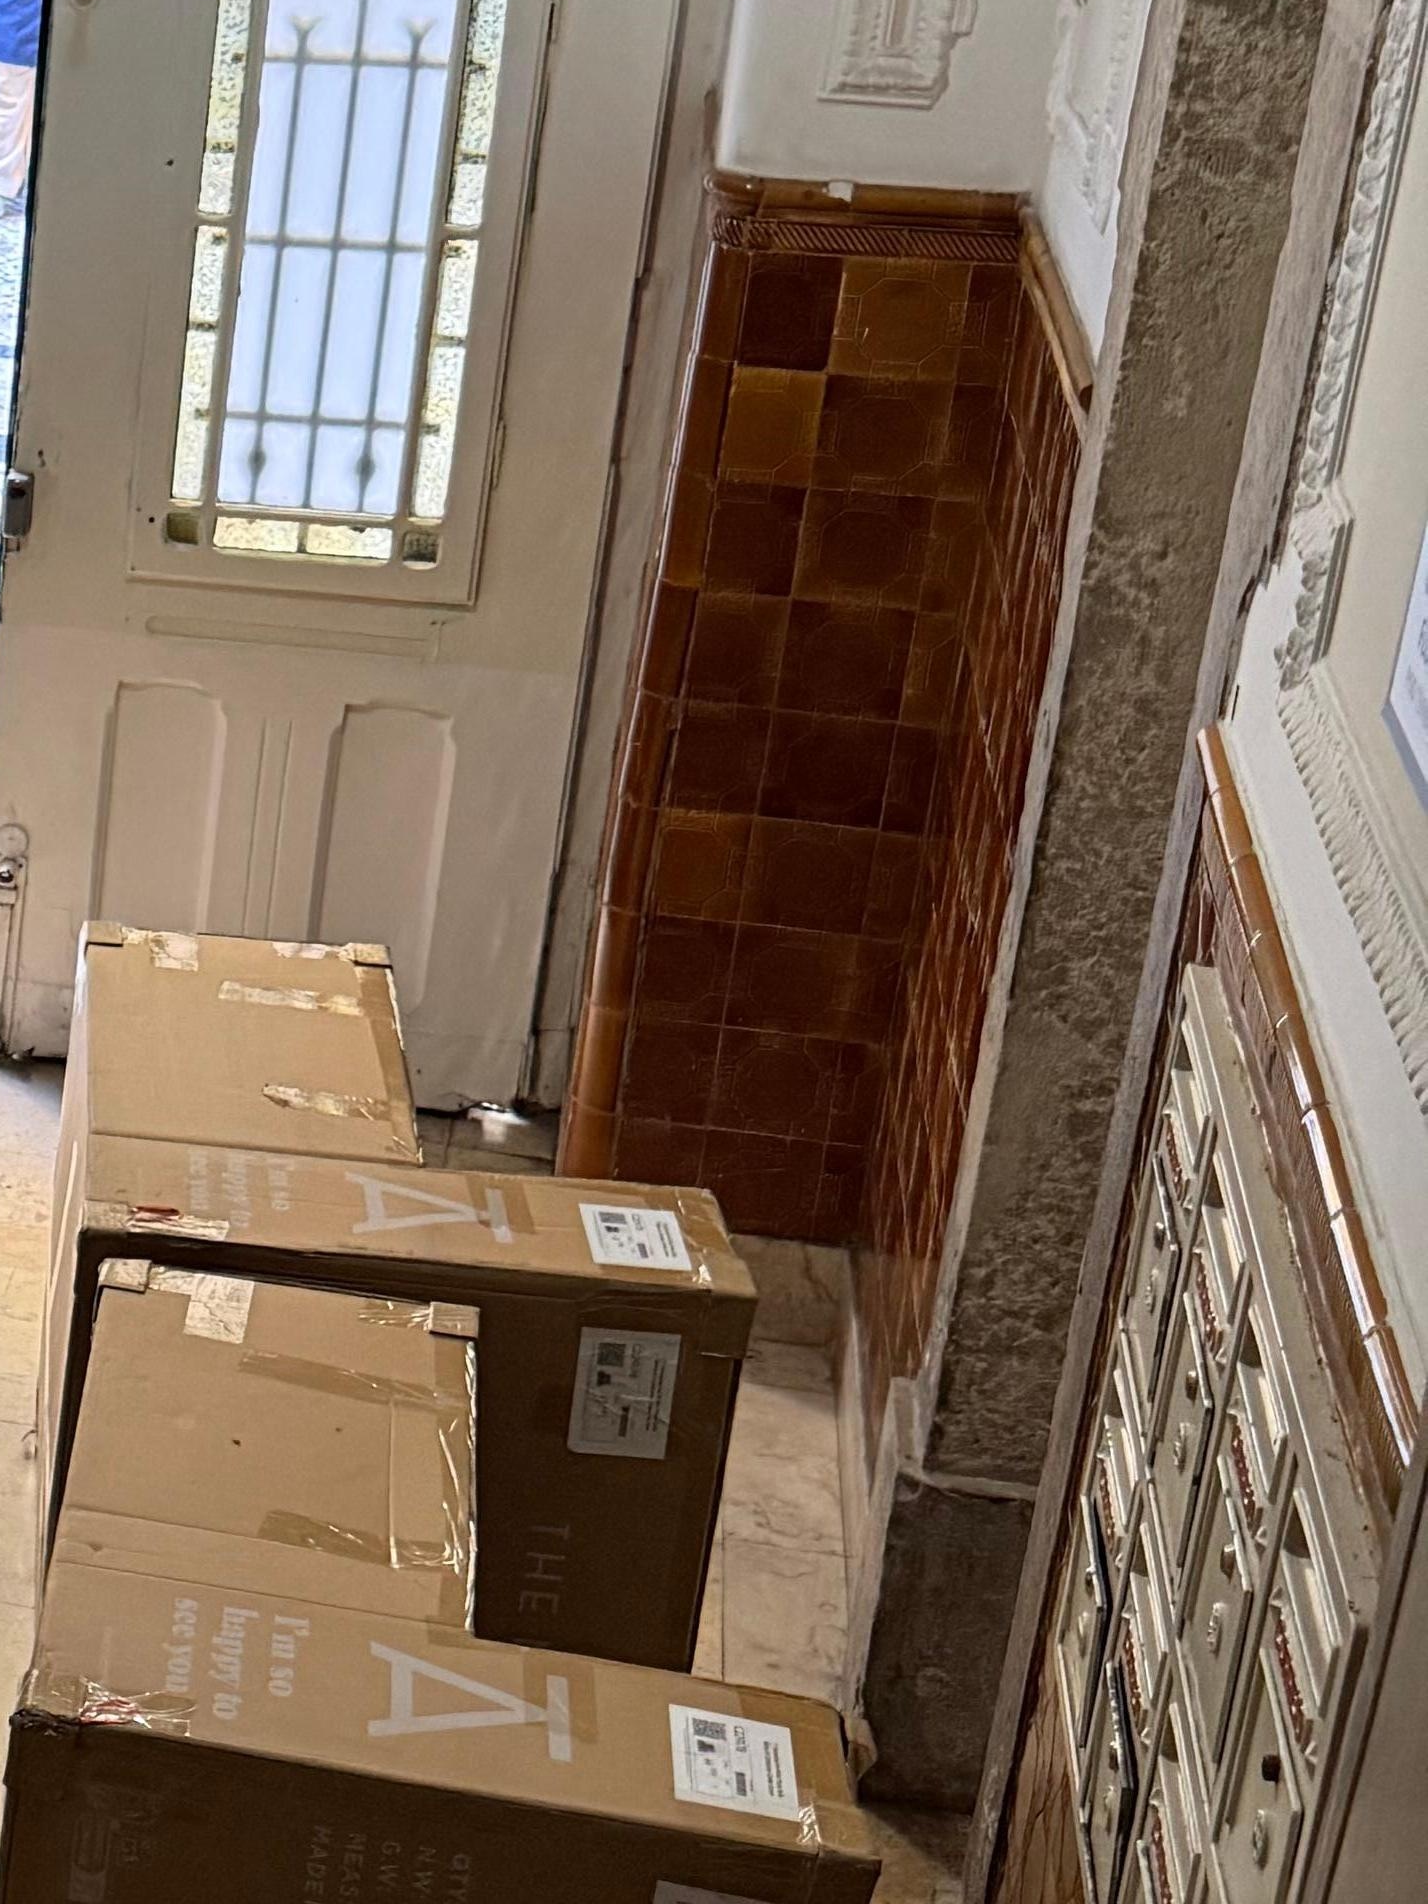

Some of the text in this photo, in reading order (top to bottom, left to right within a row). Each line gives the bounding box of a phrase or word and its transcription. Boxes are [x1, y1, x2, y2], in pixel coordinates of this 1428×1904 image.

[518, 1522, 572, 1619] THE
[172, 1598, 200, 1638] see
[268, 1614, 310, 1698] I'm so
[208, 1604, 261, 1721] happy to
[304, 1825, 332, 1896] MADE
